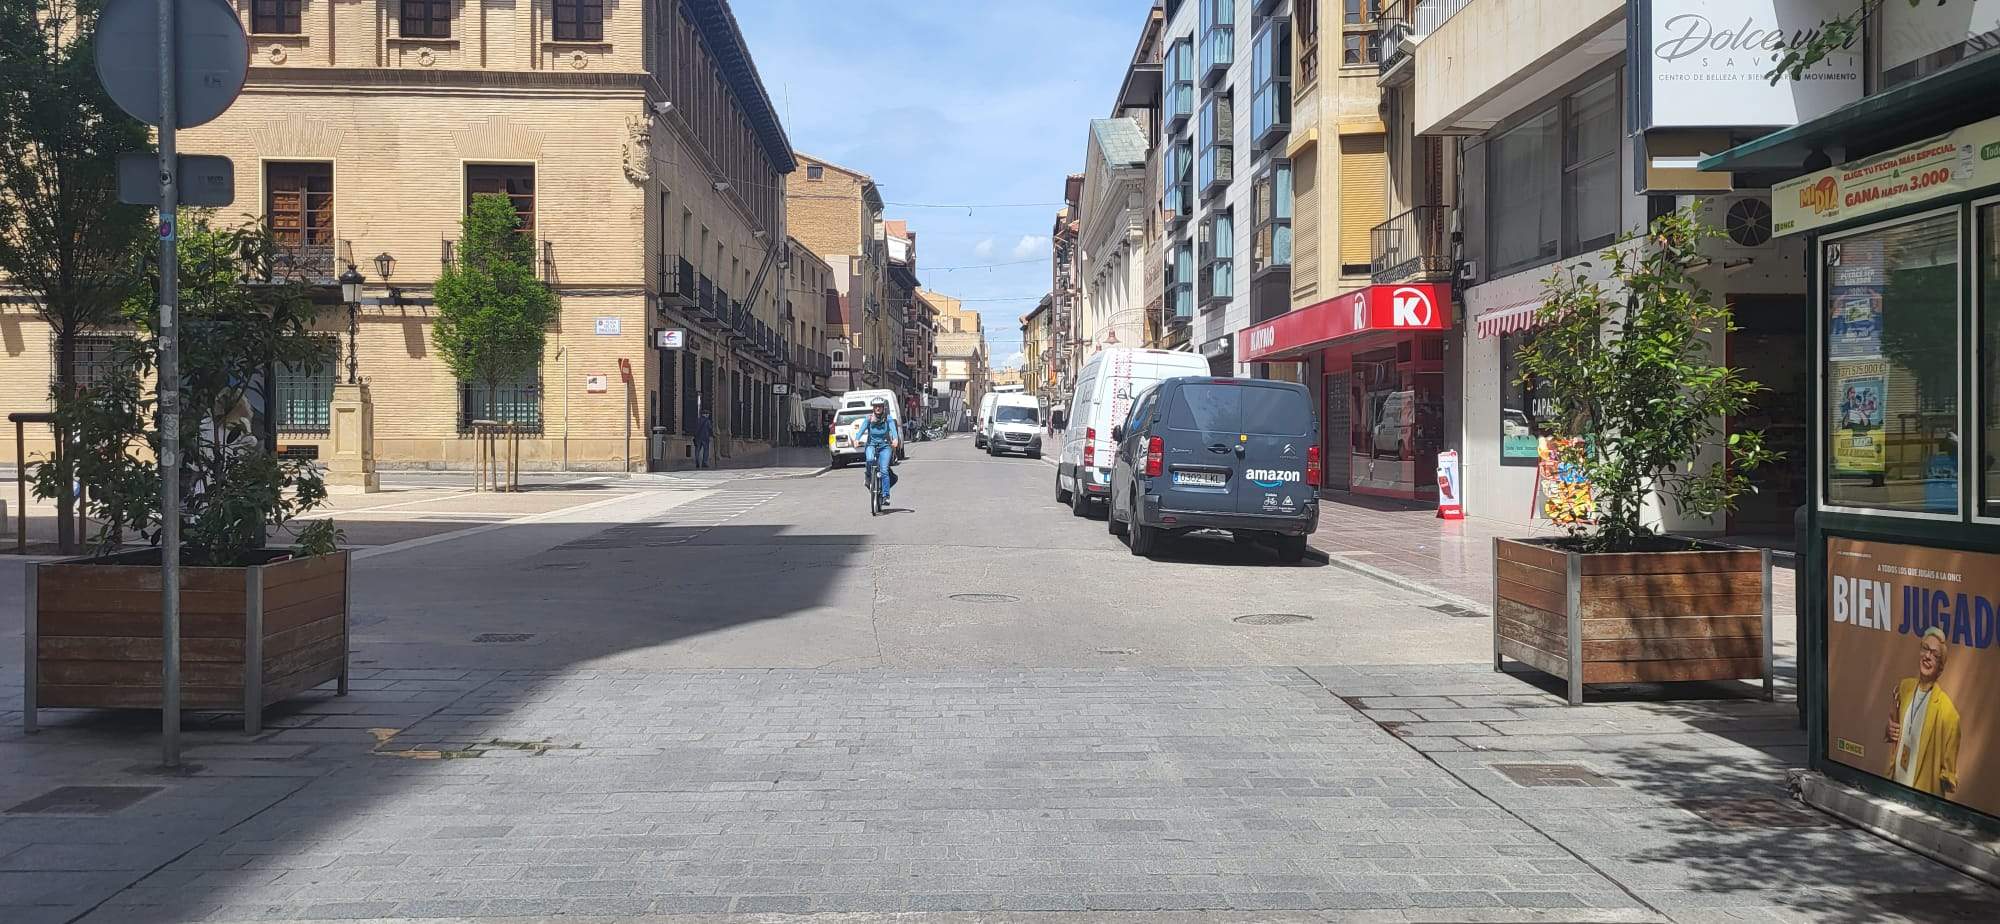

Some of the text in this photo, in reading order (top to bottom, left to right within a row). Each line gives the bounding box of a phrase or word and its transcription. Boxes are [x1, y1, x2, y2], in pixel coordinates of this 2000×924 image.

[1654, 13, 1783, 62] Dolce
[1702, 57, 1853, 67] SAVLI
[1843, 168, 1865, 181] ELIGE
[1865, 166, 1875, 176] TU
[1875, 161, 1898, 173] FECHA
[1917, 144, 1957, 161] ESPECIAL
[1985, 145, 2000, 159] Tod
[1799, 184, 1815, 208] MI
[1845, 167, 1950, 208] GANA HASTA 3.000
[1393, 297, 1421, 326] K
[1246, 468, 1300, 482] amazon
[1882, 564, 1898, 574] TODOS
[1898, 566, 1907, 576] LOS
[1907, 567, 1919, 577] QUE
[1940, 572, 1947, 580] LA
[1947, 573, 1962, 582] ONCE
[1833, 575, 2000, 649] BIEN JUGAD
